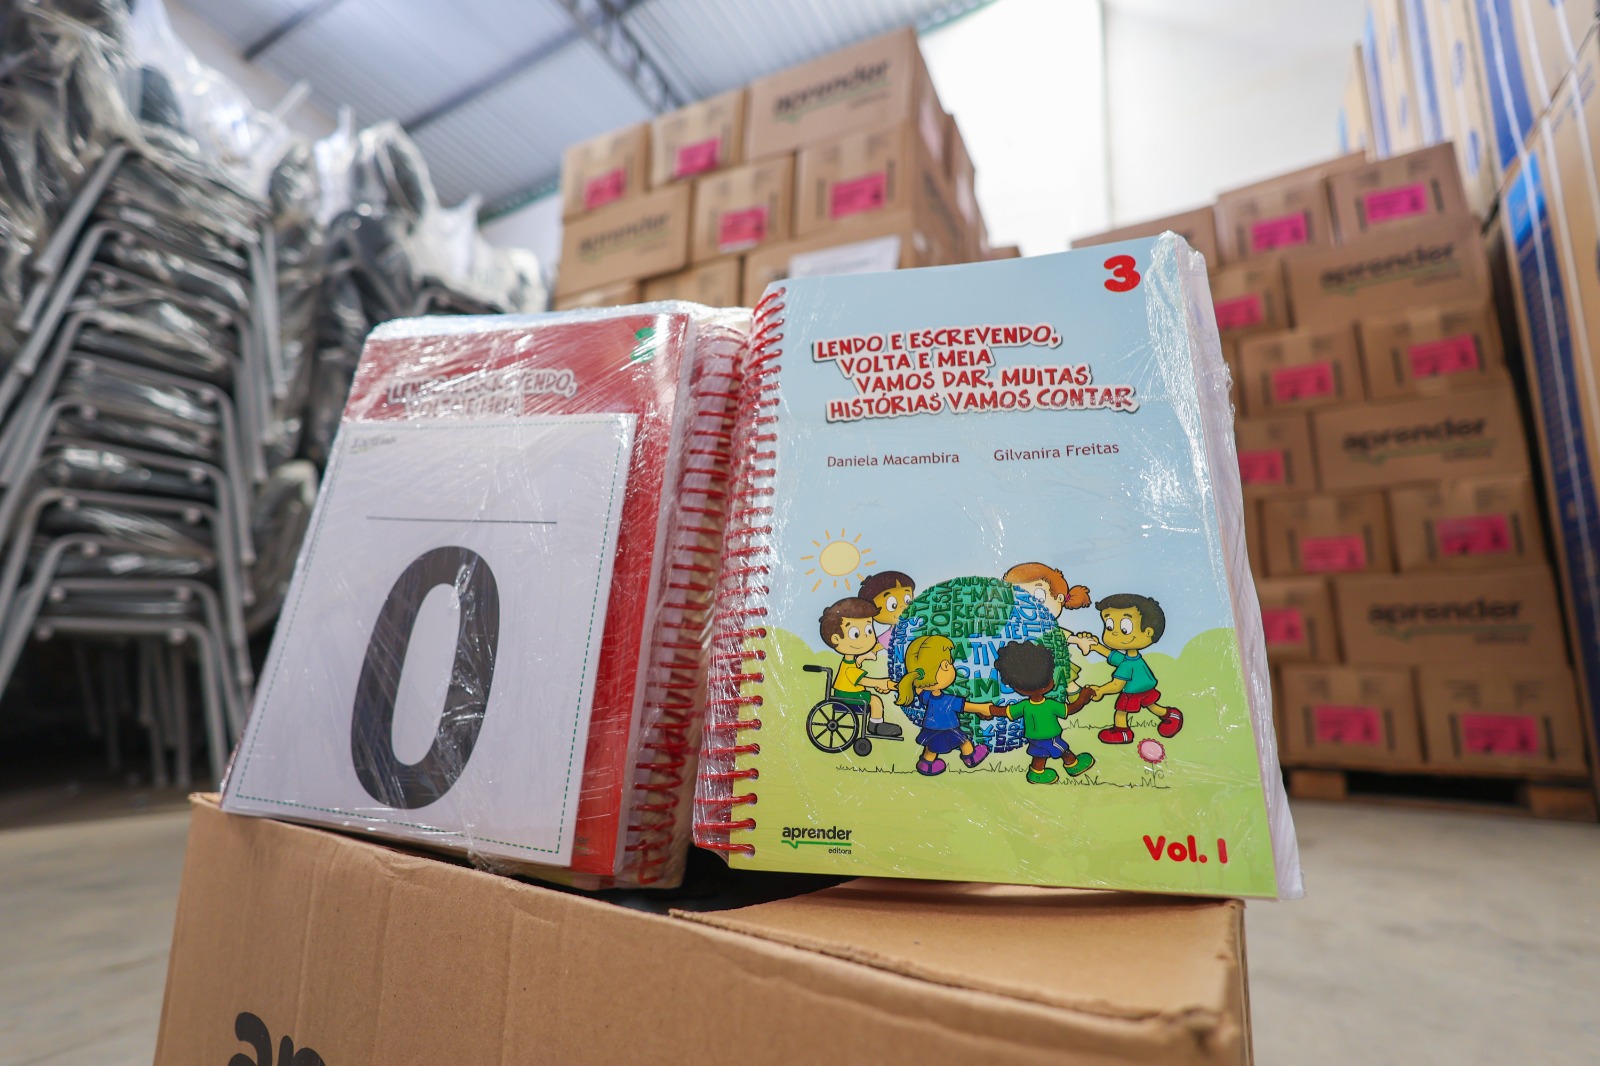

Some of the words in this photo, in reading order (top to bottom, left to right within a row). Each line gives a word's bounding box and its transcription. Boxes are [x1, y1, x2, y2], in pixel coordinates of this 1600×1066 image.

[1103, 255, 1141, 292] 3
[817, 335, 883, 359] LENDO
[891, 333, 904, 351] E
[910, 326, 1059, 349] ESCREVENDO,
[841, 353, 911, 374] VOLTA
[918, 352, 930, 369] E
[937, 349, 992, 368] MEIA
[856, 371, 935, 393] VAMOS
[942, 369, 994, 389] DAR,
[1001, 366, 1088, 386] MUITAS
[830, 391, 942, 418] HISTÓRIAS
[948, 389, 1031, 410] VAMOS
[1036, 388, 1133, 408] CONTAR
[827, 455, 878, 467] Daniela
[883, 452, 960, 466] Macambira
[993, 448, 1061, 461] Gilvanira
[1066, 443, 1120, 457] Freitas
[351, 545, 499, 810] 0
[782, 826, 852, 841] aprender
[828, 847, 852, 855] editora
[1142, 834, 1208, 864] Vol.
